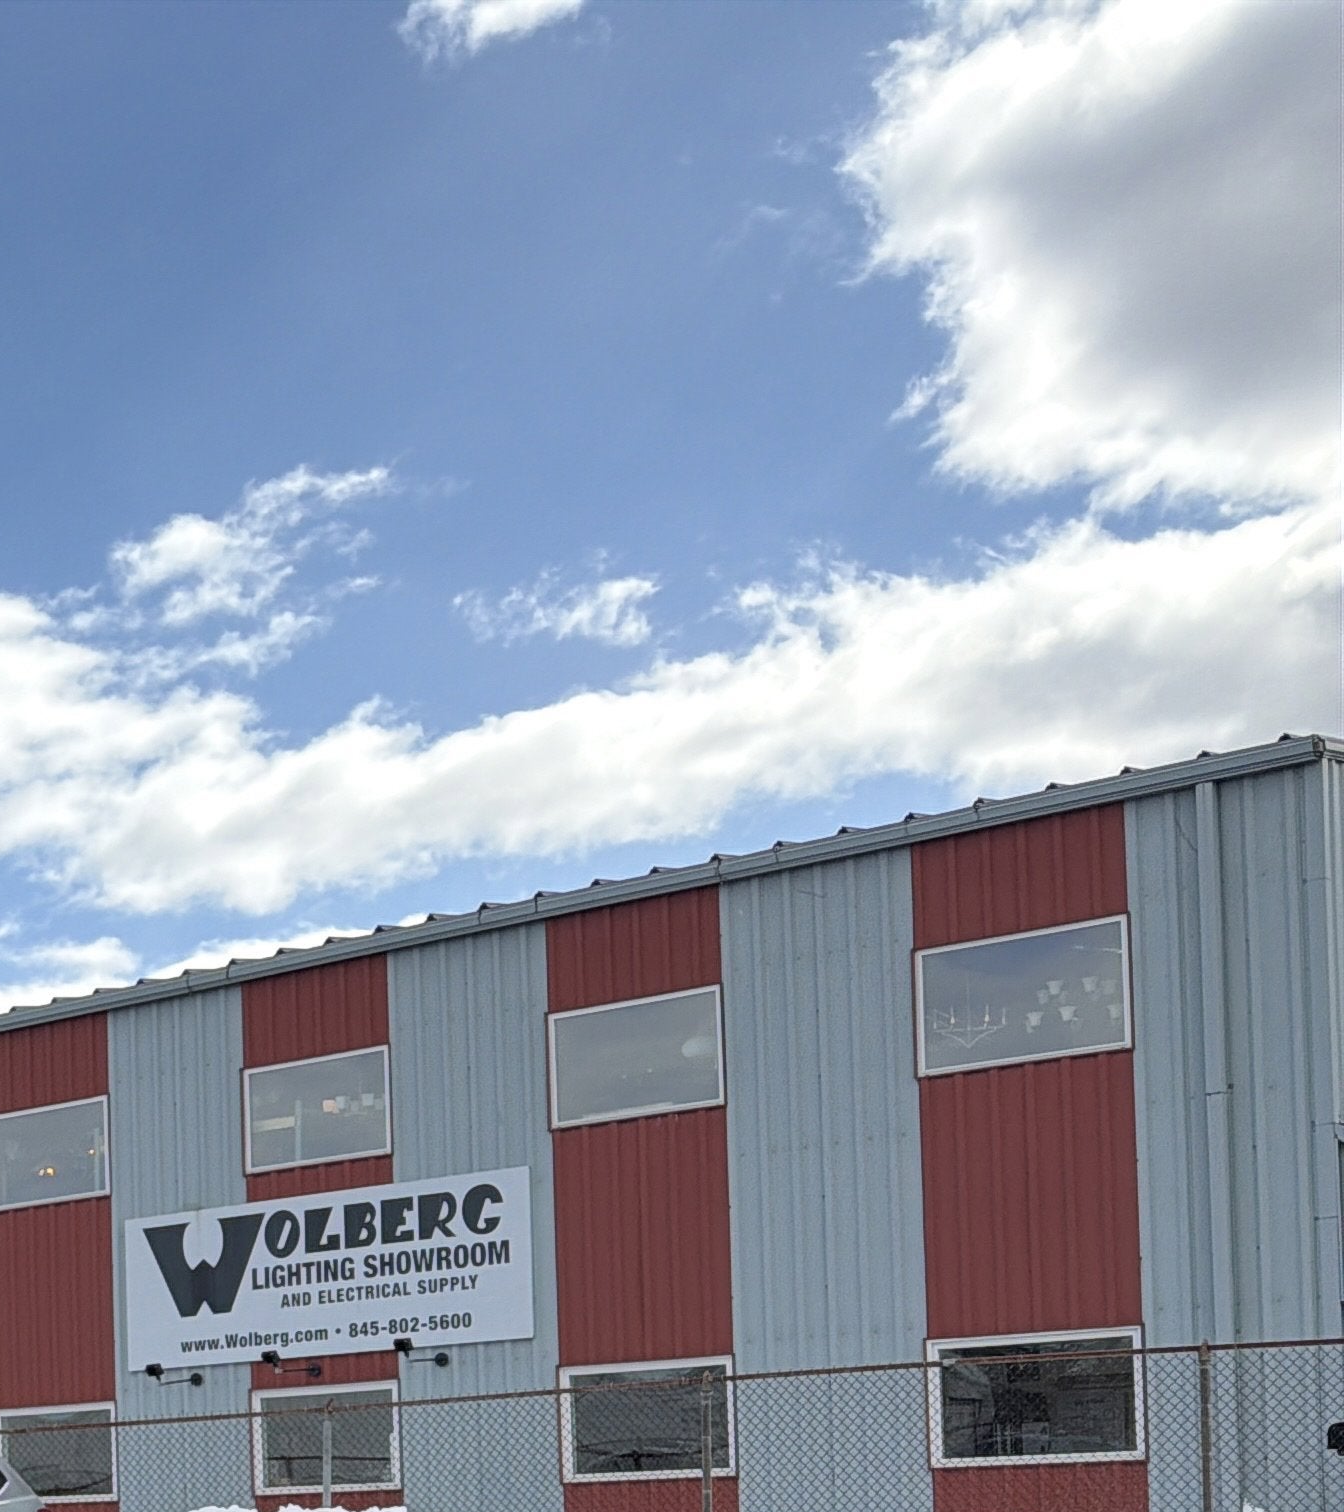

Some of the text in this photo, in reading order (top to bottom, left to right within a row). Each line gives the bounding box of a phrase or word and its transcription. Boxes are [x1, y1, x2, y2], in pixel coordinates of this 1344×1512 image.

[143, 1184, 503, 1317] WOLBERG
[251, 1239, 510, 1290] LIGHTING SHOWROOM
[280, 1274, 479, 1309] AND ELECTRICAL SUPPLY
[180, 1312, 472, 1353] www.Wolberg.com 845-802-5600
